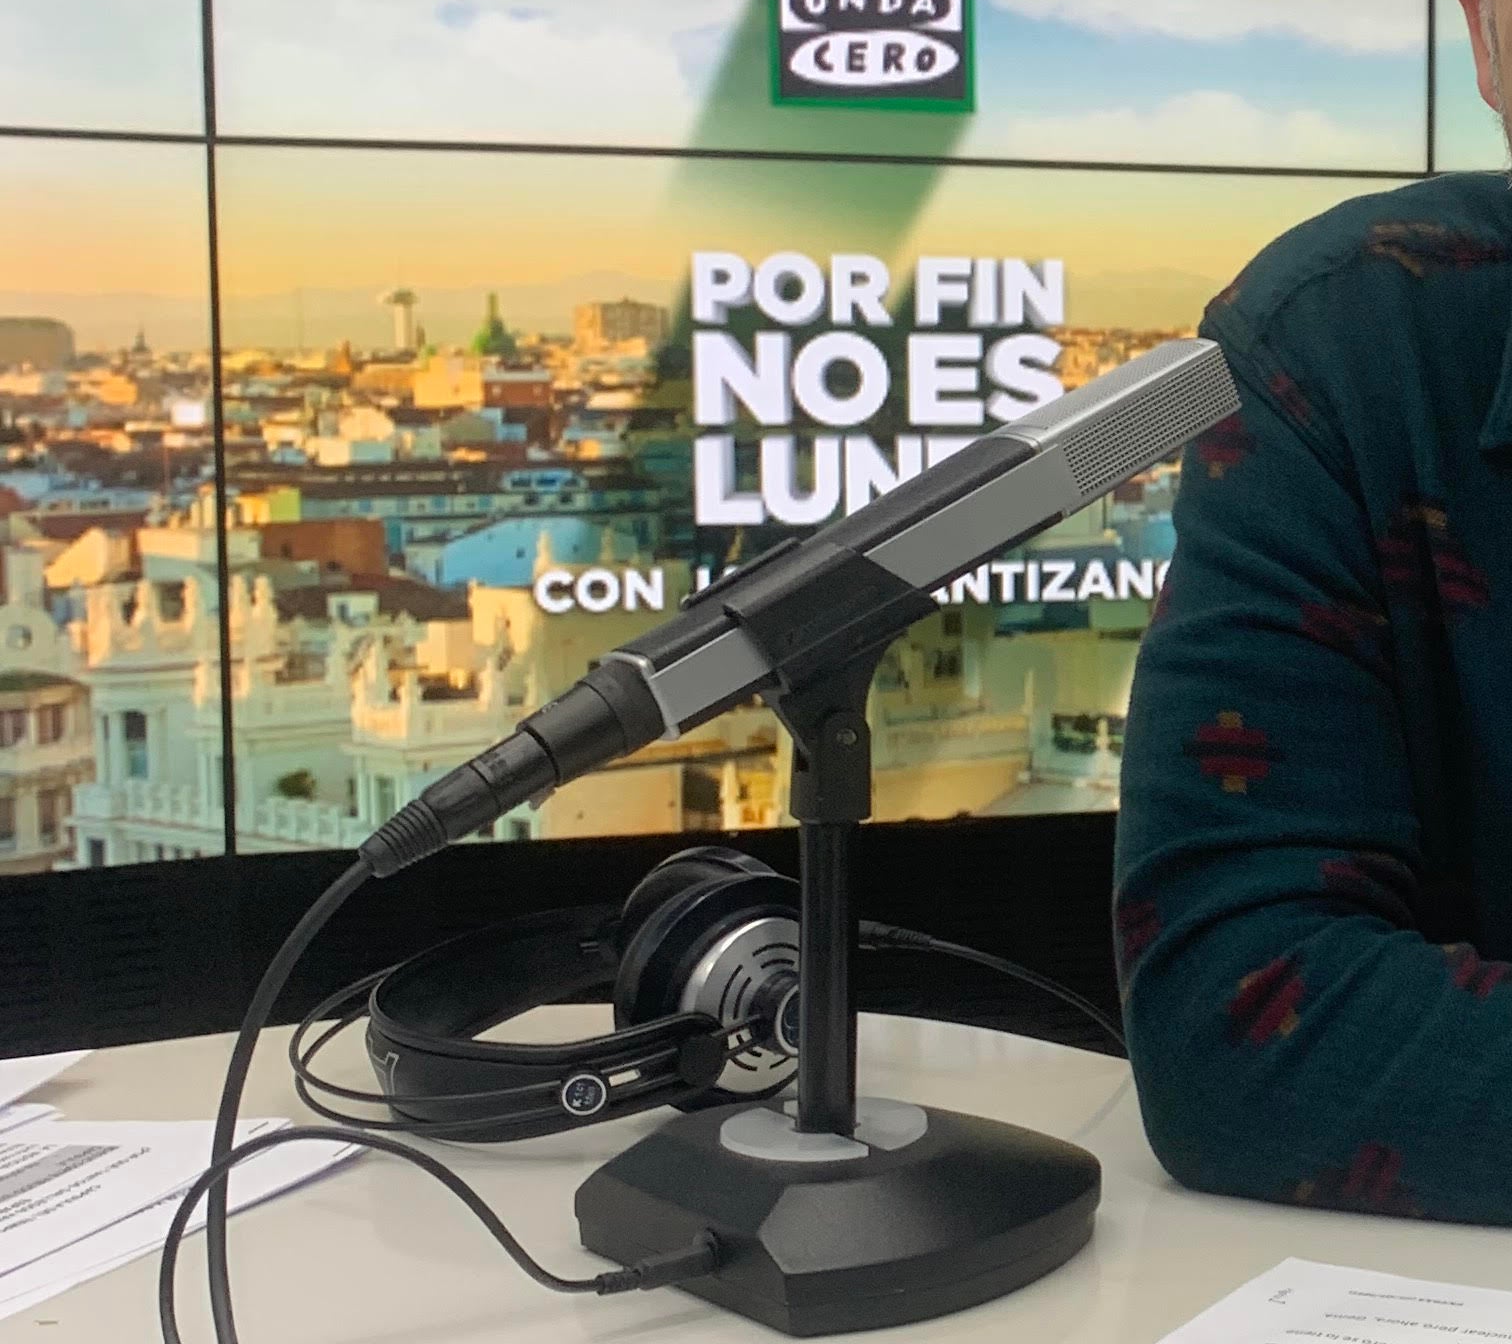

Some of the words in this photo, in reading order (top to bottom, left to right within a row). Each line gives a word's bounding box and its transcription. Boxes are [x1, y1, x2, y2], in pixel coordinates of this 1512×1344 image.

[813, 41, 937, 73] CERO
[692, 251, 894, 326] POR
[916, 256, 1064, 326] FIN
[694, 331, 890, 426] NO
[907, 332, 1063, 426] ES
[695, 434, 982, 525] LUN
[533, 567, 665, 614] CON
[929, 558, 1171, 605] NTIZAN
